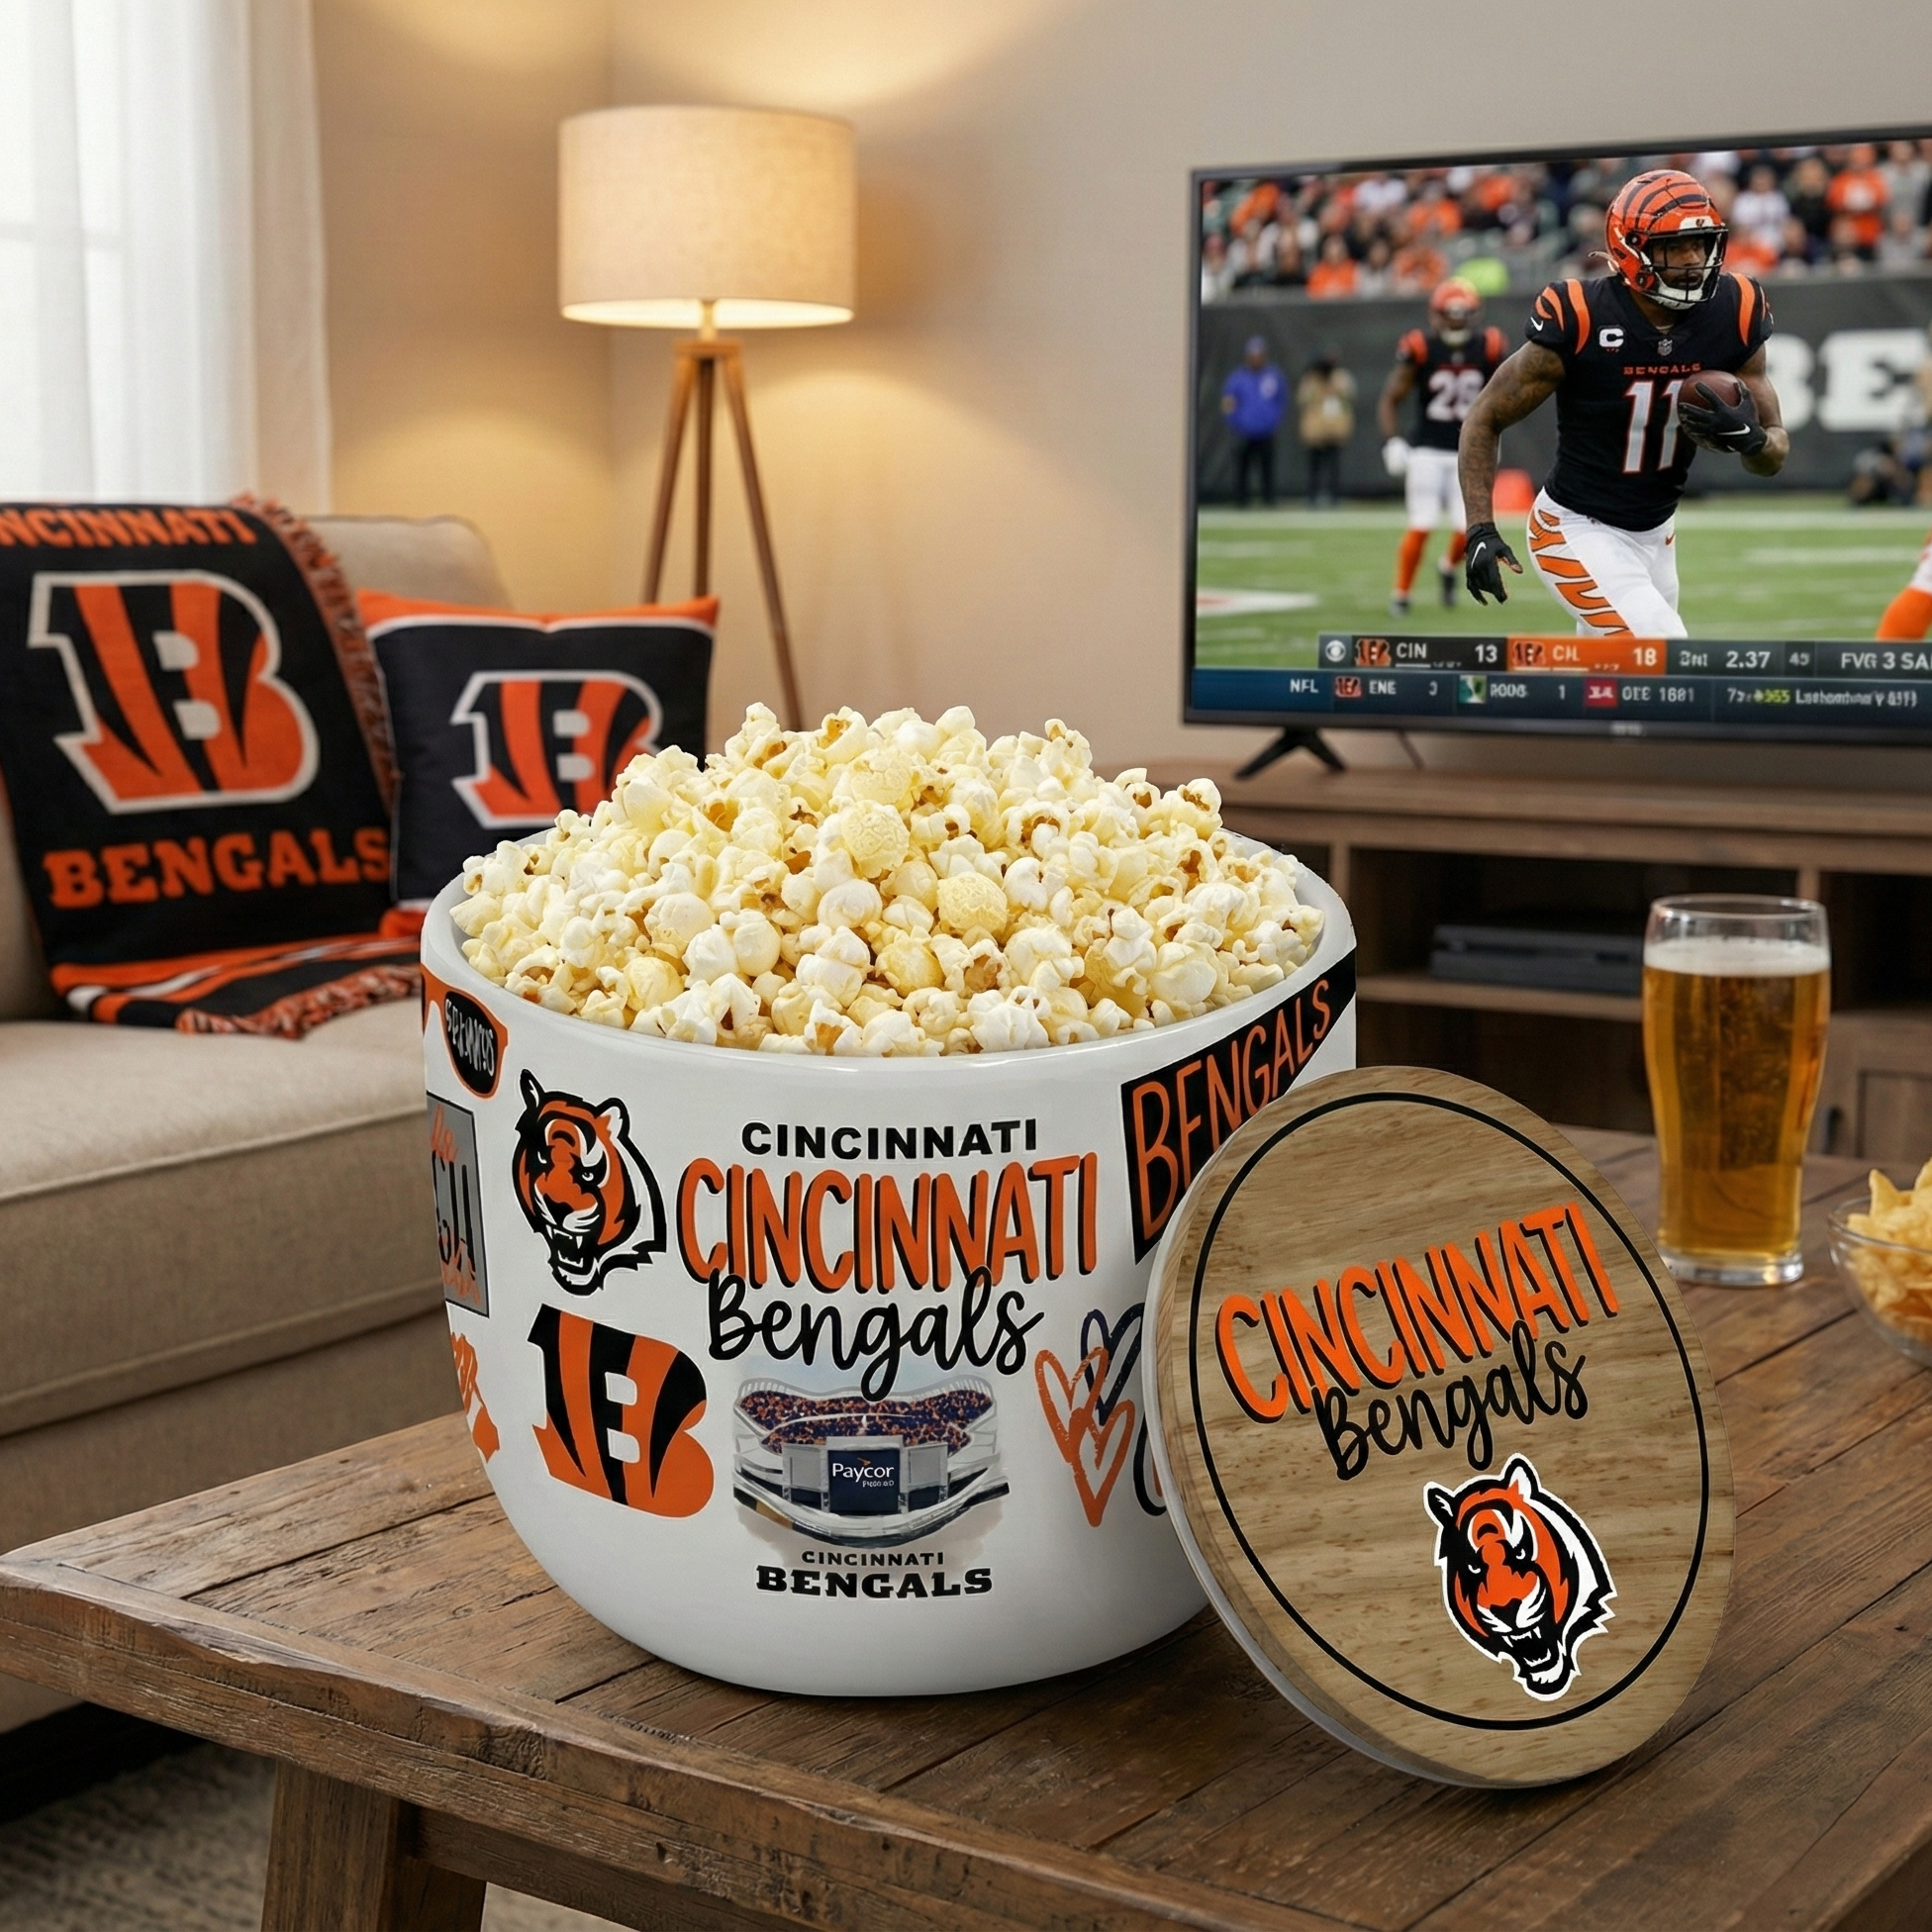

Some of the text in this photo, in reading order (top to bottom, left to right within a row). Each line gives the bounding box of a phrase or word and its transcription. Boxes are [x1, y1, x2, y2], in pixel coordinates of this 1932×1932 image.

[1599, 328, 1624, 346] C
[1623, 362, 1701, 375] BENGALS
[1623, 380, 1683, 472] 11
[1396, 642, 1427, 659] CIN
[1475, 644, 1498, 664] 13
[1633, 646, 1657, 667] 18
[1726, 651, 1771, 669] 2.37
[1883, 652, 1895, 670] 3
[1290, 679, 1318, 694] NFL
[43, 827, 391, 910] BENGALS
[1132, 979, 1329, 1240] BENGALS
[741, 1118, 1036, 1160] CINCINNATI
[676, 1151, 1098, 1295] CINCINNATI
[1215, 1202, 1620, 1423] CINCINNATI
[708, 1265, 1044, 1401] Bengals
[1311, 1319, 1589, 1480] Bengals
[832, 1463, 895, 1483] Paycor
[801, 1550, 943, 1566] CINCINNATI
[756, 1565, 993, 1599] BENGALS
